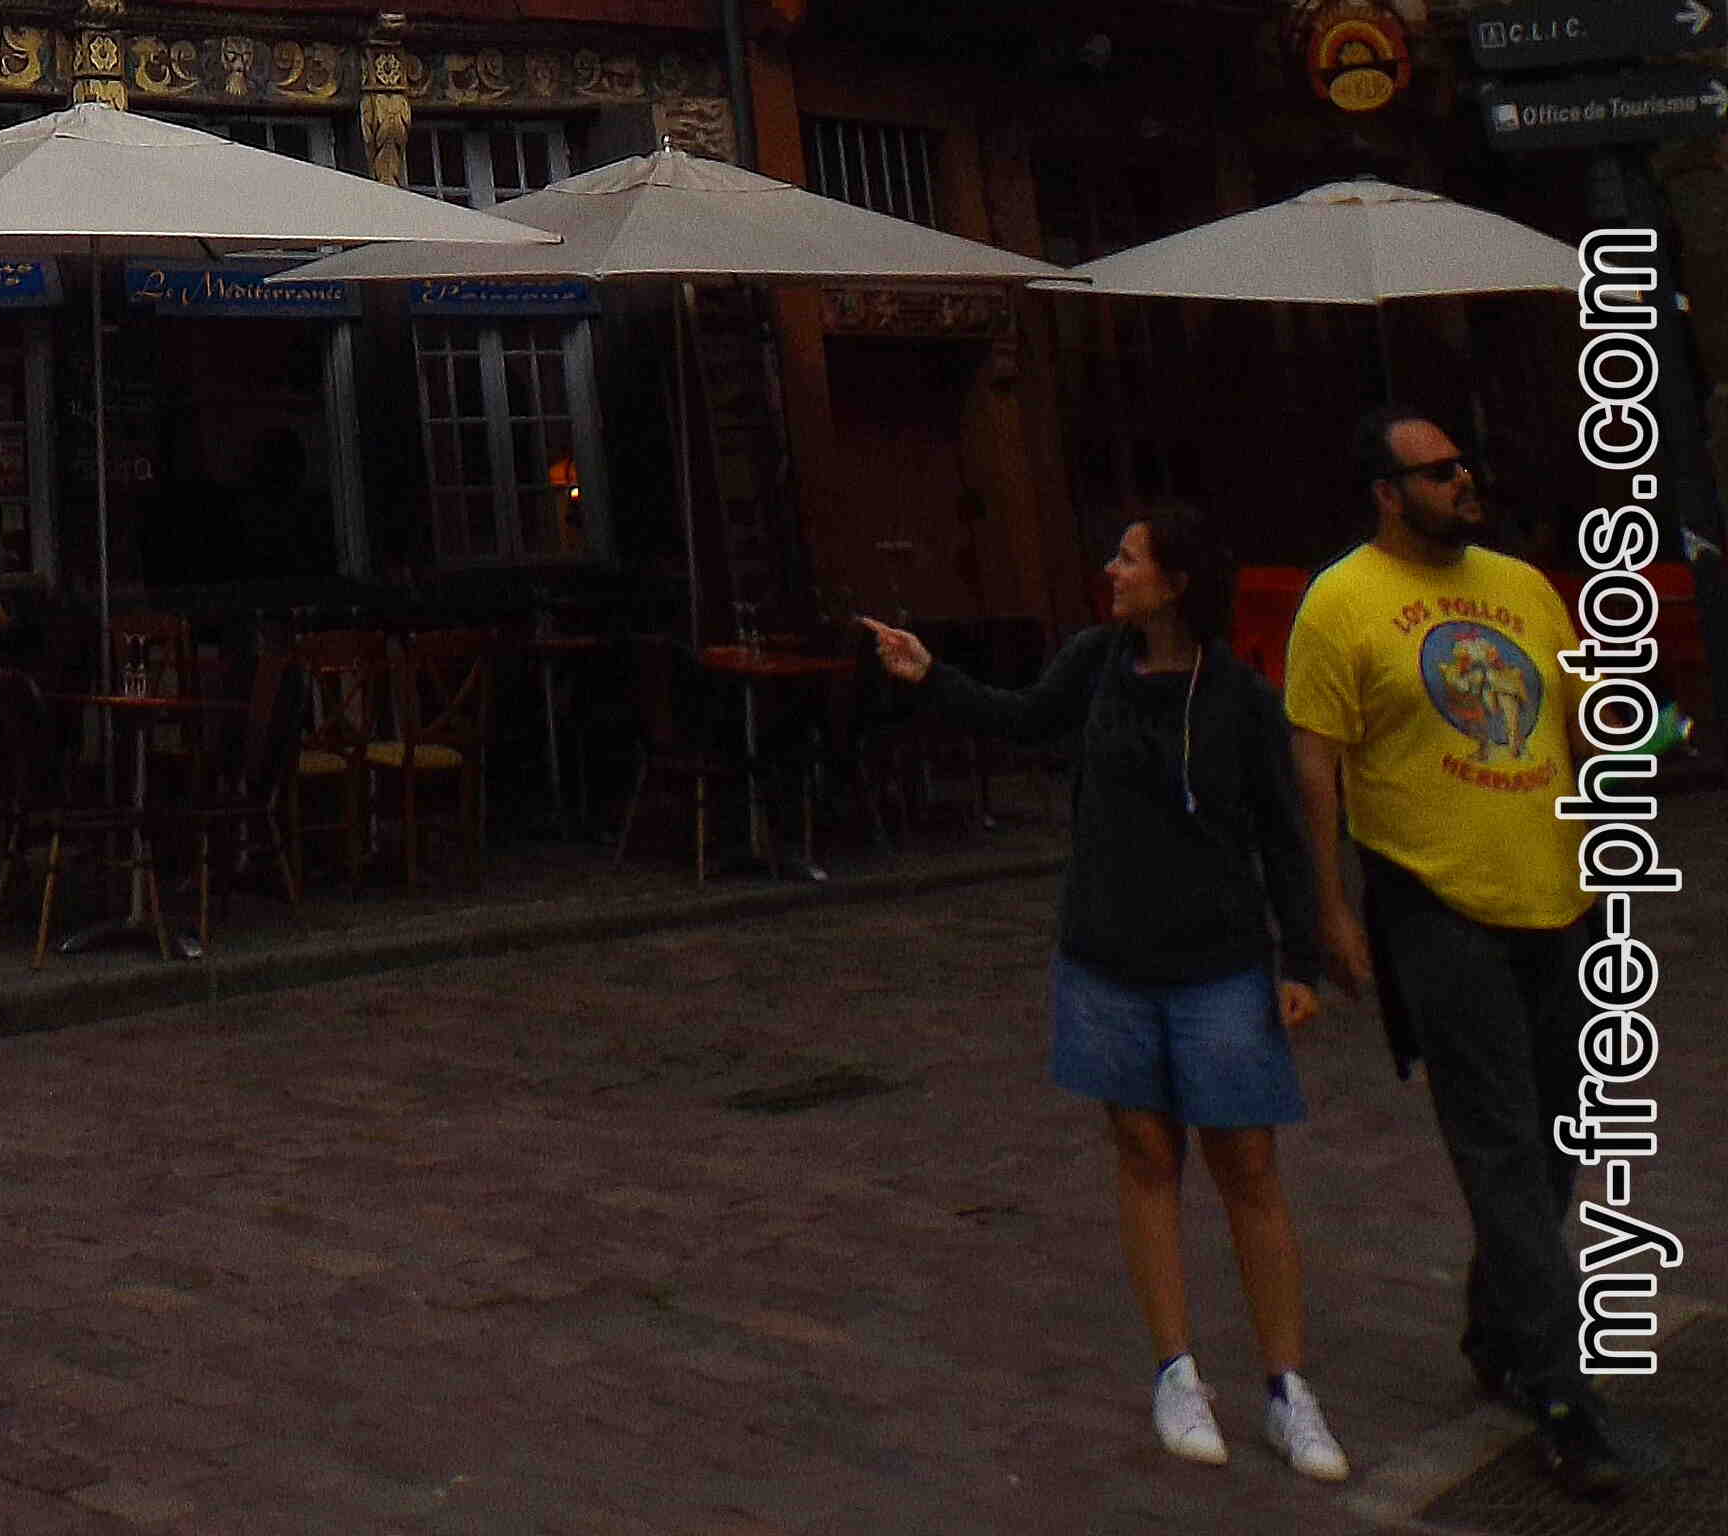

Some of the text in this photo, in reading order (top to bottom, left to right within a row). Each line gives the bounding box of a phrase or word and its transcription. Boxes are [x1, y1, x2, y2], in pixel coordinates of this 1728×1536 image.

[1522, 93, 1698, 127] Office de Tourisme
[1437, 596, 1524, 633] POLLOS
